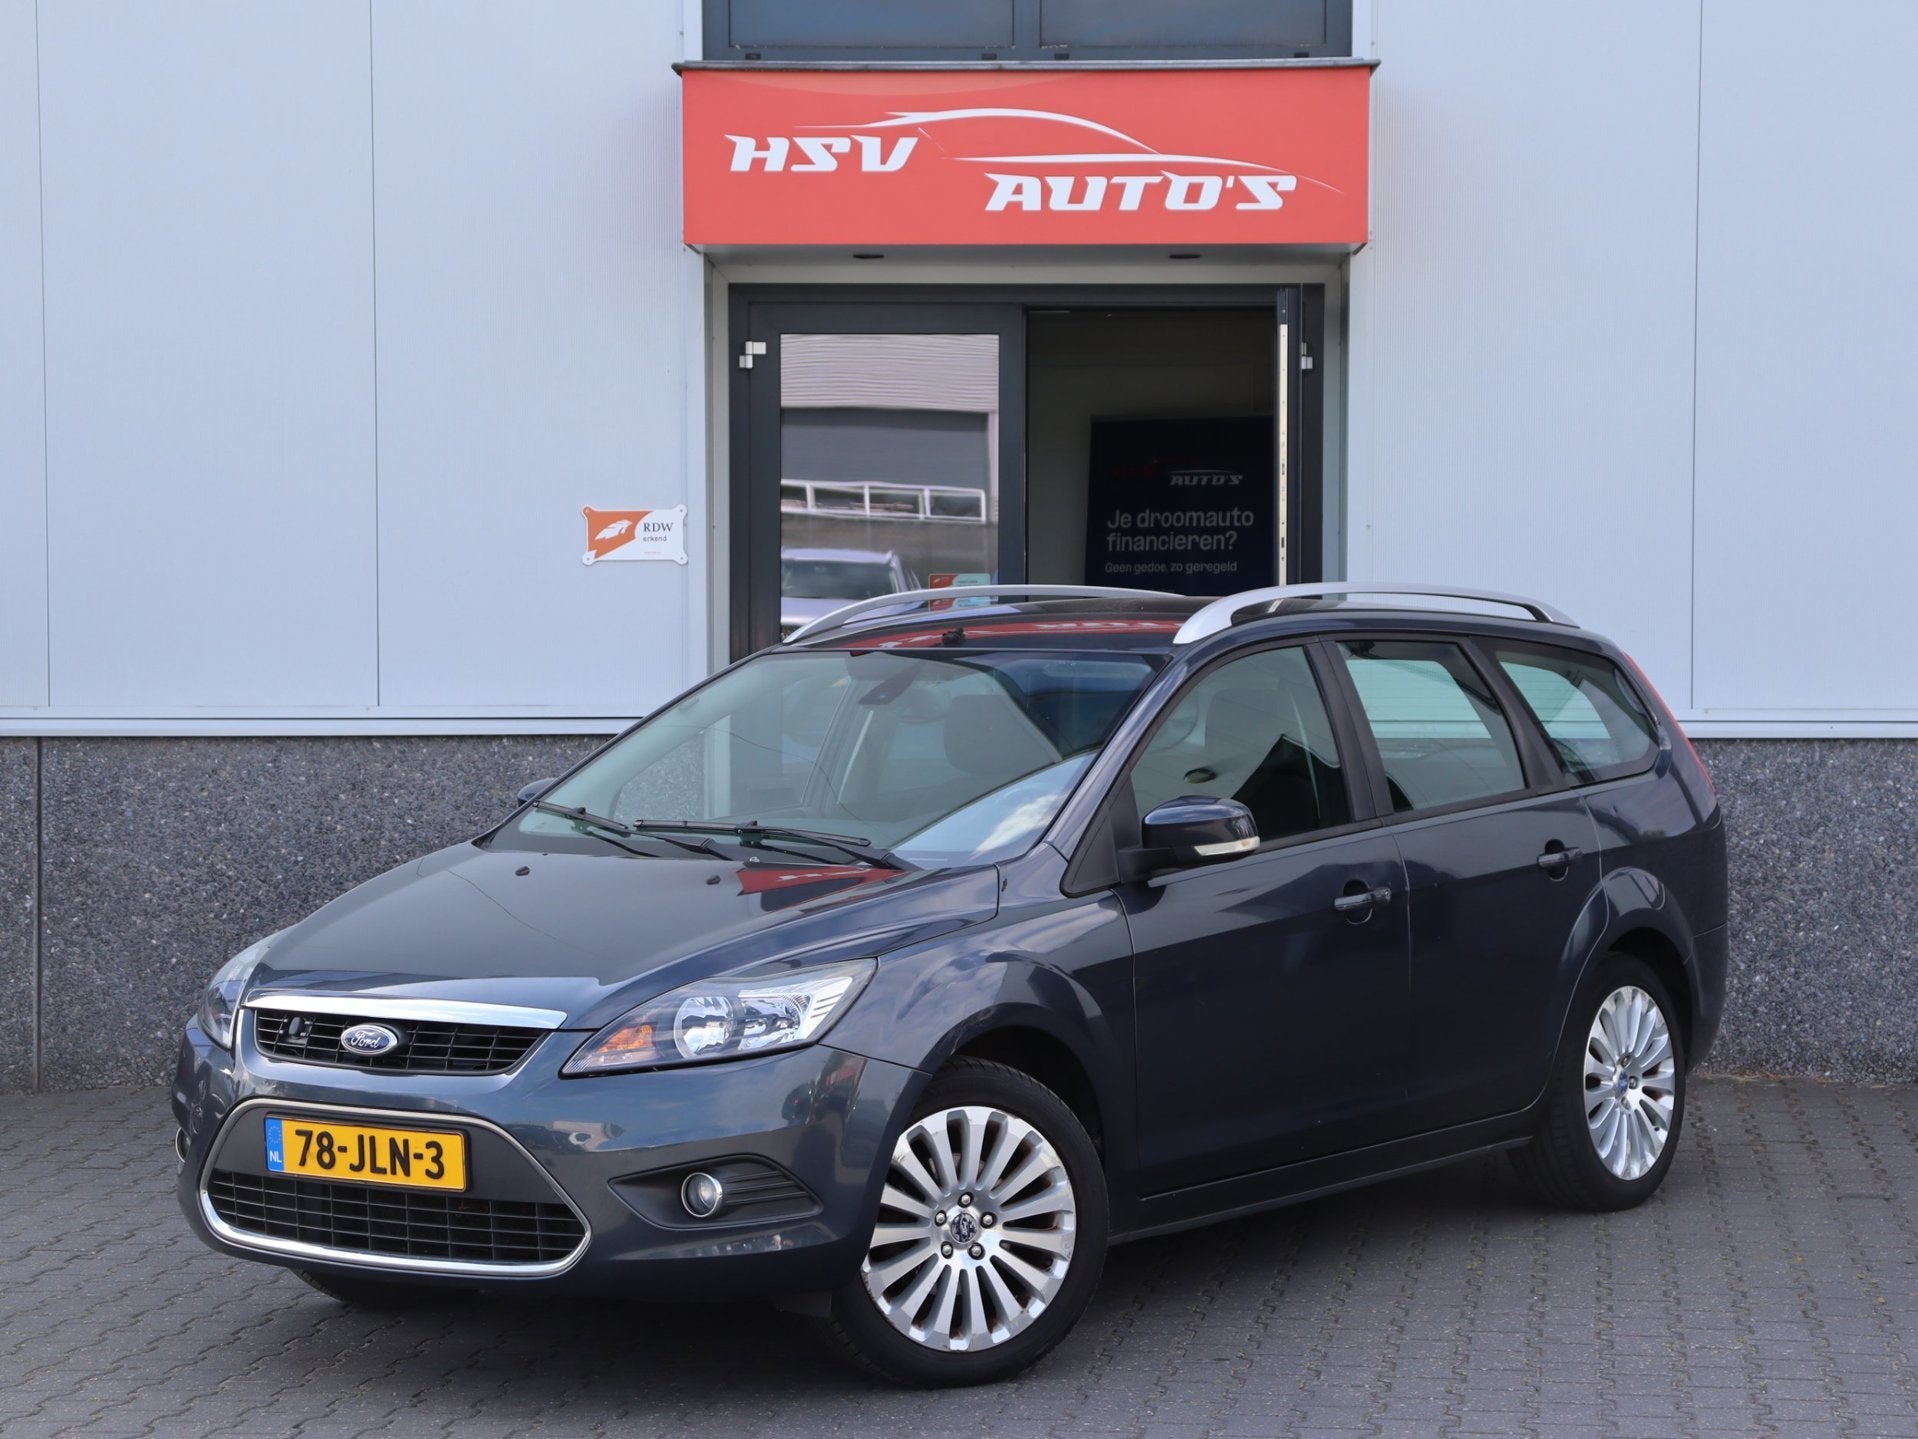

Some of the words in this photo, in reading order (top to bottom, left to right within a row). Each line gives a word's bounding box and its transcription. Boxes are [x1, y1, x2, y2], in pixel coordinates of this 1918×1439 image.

[724, 134, 918, 173] HSV
[984, 171, 1297, 212] AUTO'S
[1169, 474, 1243, 487] AUTO'S
[643, 522, 674, 533] RDW
[1107, 509, 1132, 528] Je
[1137, 507, 1254, 528] droomauto
[643, 535, 667, 543] erkend
[1106, 531, 1238, 552] financieren?
[1105, 562, 1132, 573] Geen
[1170, 562, 1183, 572] zo
[1185, 561, 1238, 574] geregeld
[350, 1030, 381, 1049] Ford
[269, 1150, 283, 1164] NL
[295, 1129, 445, 1180] 78-JLN-3
